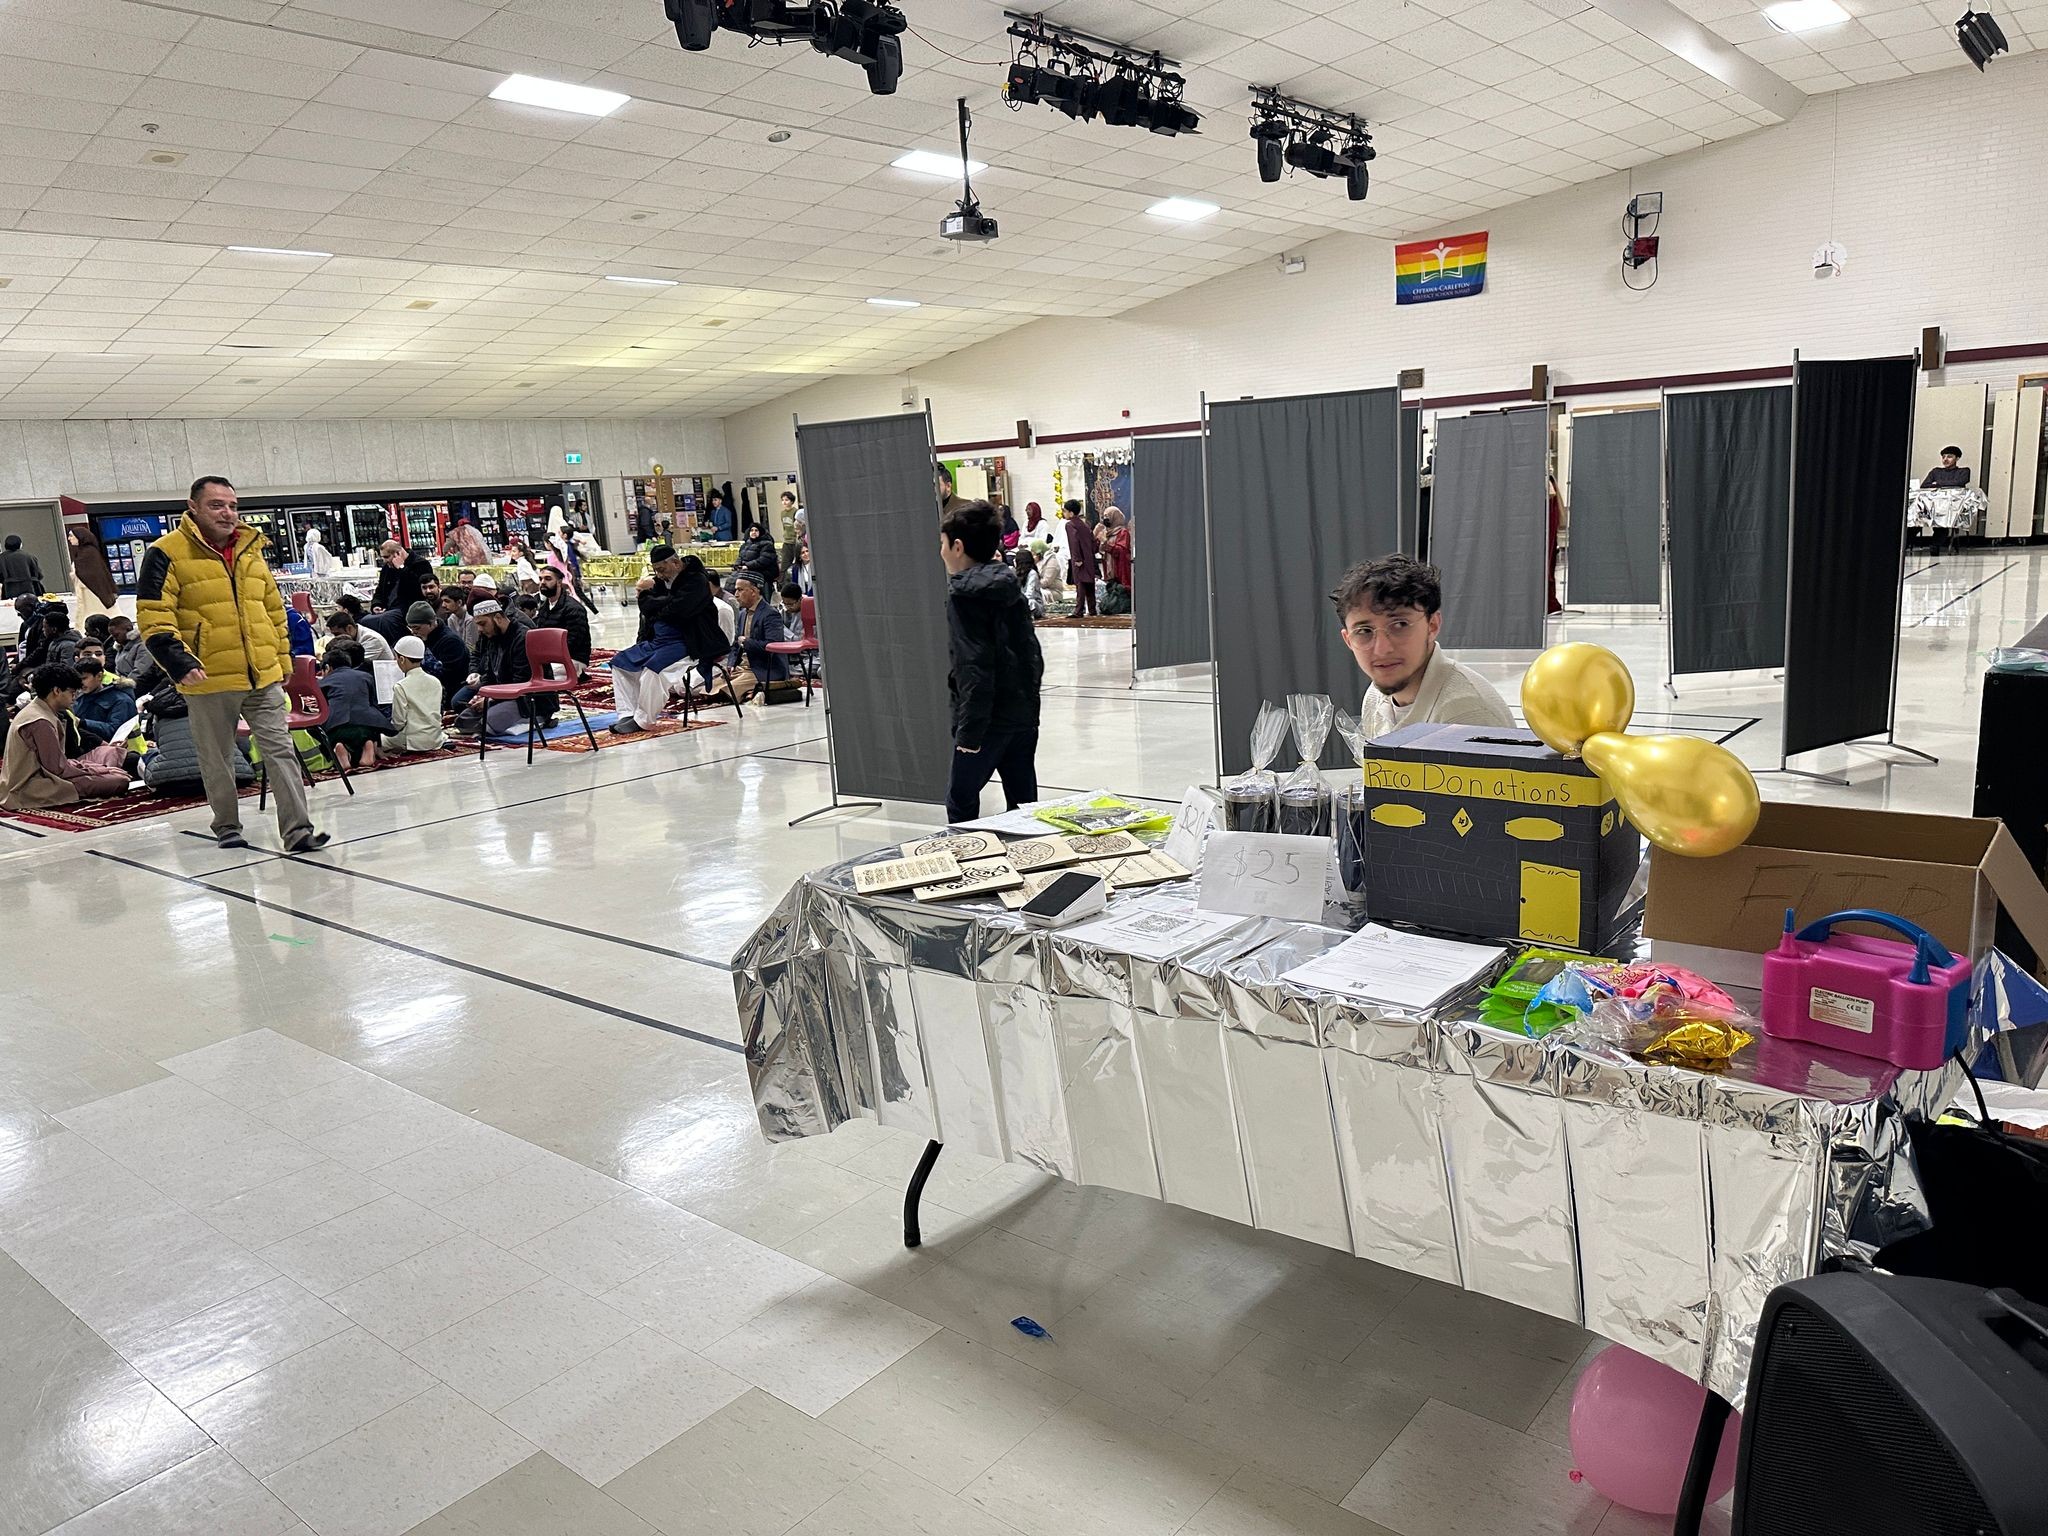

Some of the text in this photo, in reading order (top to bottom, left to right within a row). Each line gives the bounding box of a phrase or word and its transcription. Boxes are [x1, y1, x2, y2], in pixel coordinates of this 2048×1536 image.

[121, 521, 152, 535] AQUAFINA
[1423, 763, 1571, 803] Donations
[1226, 846, 1300, 888] $25
